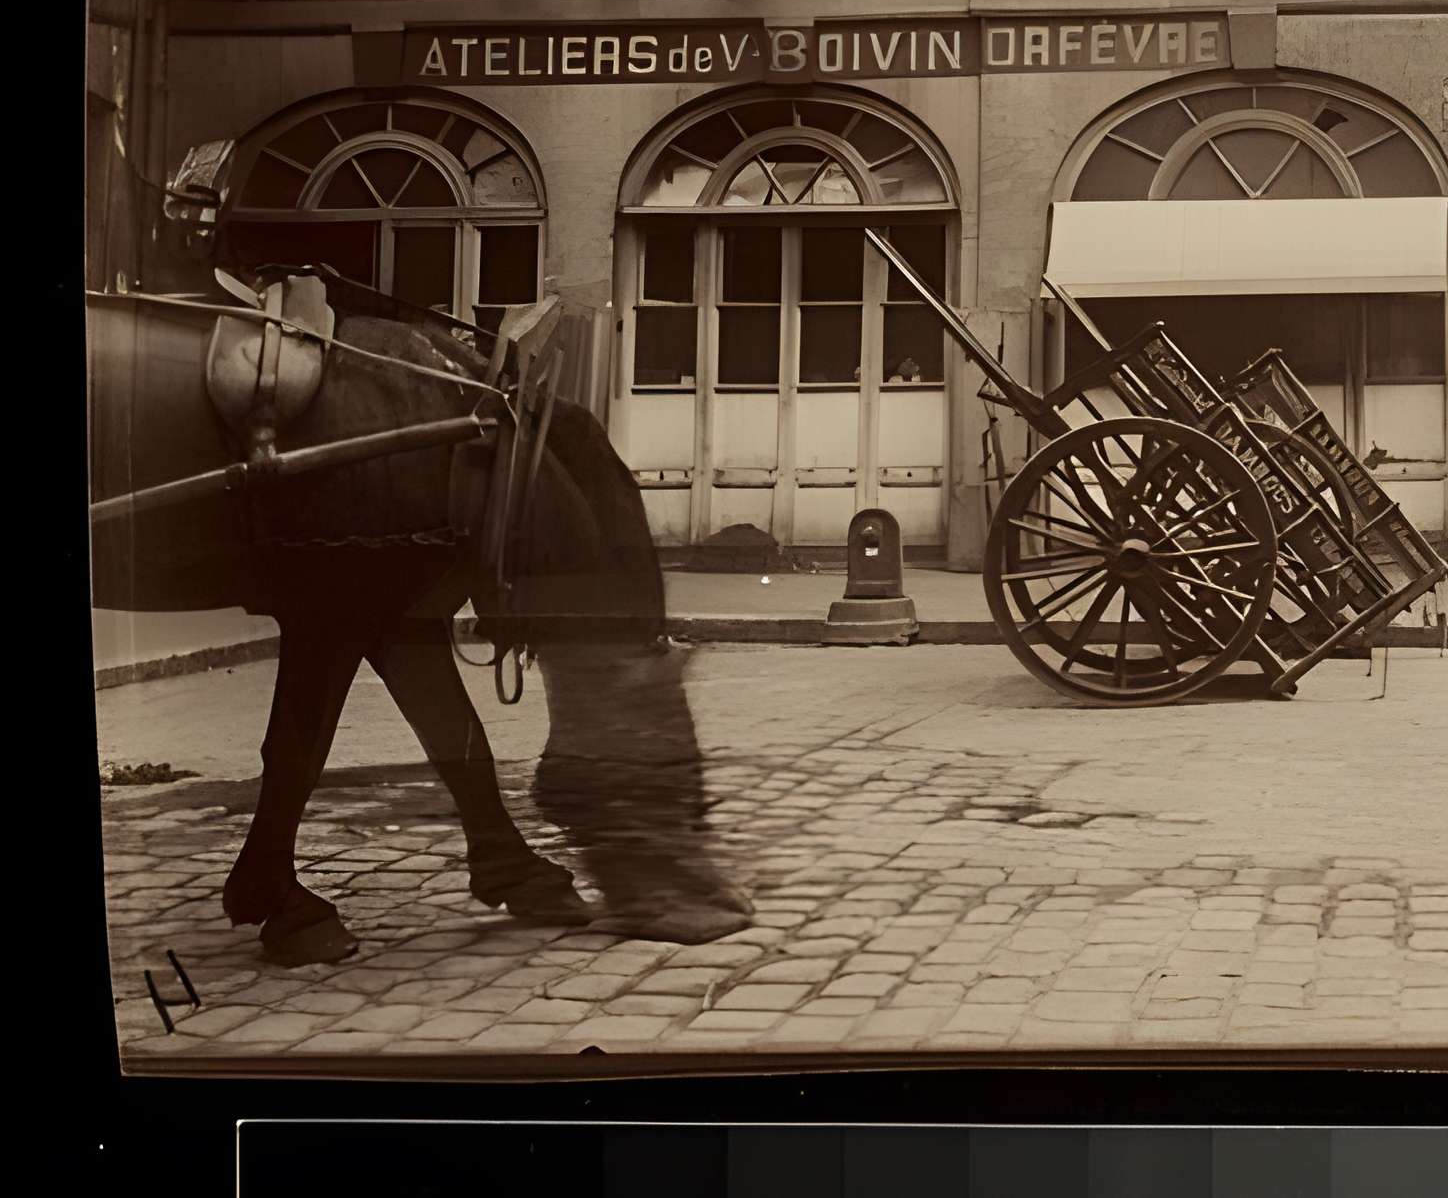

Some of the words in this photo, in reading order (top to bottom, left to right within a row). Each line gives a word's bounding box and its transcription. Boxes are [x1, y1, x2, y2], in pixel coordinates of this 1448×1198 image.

[419, 35, 657, 76] ATELIERS
[668, 34, 712, 74] de
[769, 29, 962, 72] BOIVIN
